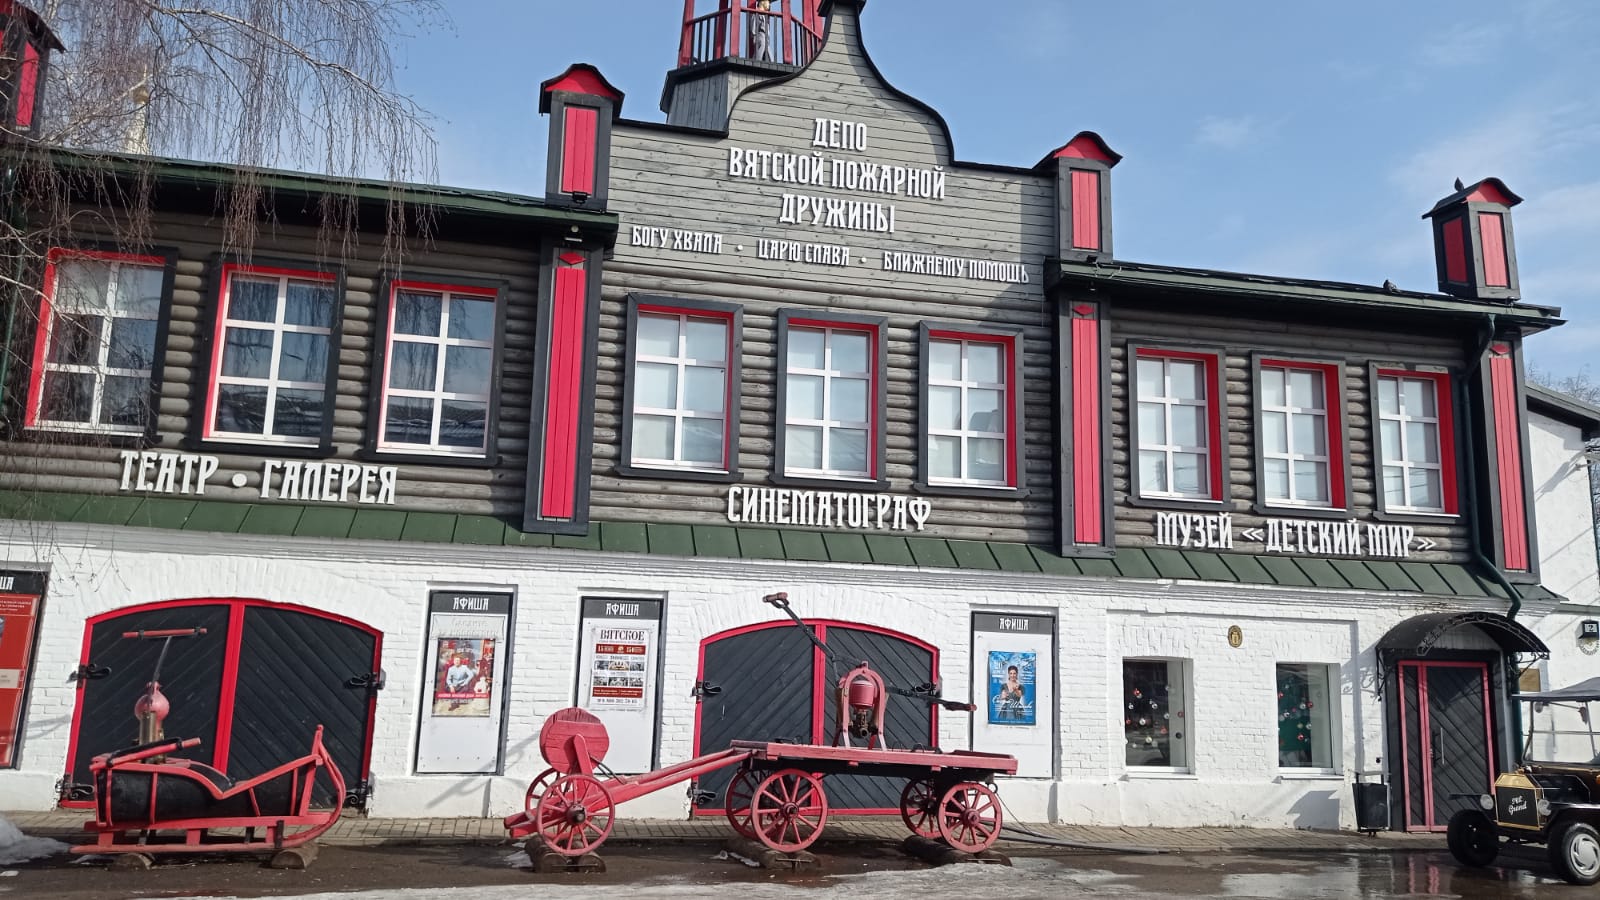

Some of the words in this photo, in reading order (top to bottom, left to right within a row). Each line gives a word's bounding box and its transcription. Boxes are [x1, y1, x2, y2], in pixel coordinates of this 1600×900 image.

[813, 118, 867, 151] ДЕПО
[729, 147, 825, 186] ВЯТСКОЙ
[831, 159, 946, 199] ПОЖАРНОЙ
[779, 194, 895, 233] ДРУЖИНЫ
[632, 226, 669, 248] БОГУ
[672, 231, 722, 254] ХВАЛА
[757, 239, 801, 262] ЦАРЮ
[805, 243, 850, 267] СЛАВА
[883, 252, 964, 278] БЛИЖНЕМУ
[967, 259, 1029, 284] ПОМОЩЬ
[120, 451, 219, 495] ТЕАТР
[260, 460, 398, 505] ГАЛЕРЕЯ
[727, 486, 932, 531] СИНЕМАТОГРАФ
[1156, 511, 1233, 549] МУЗЕЙ
[453, 597, 489, 611] АФИША
[606, 603, 639, 616] АФИША
[600, 630, 645, 640] ВЯТСКОЕ
[1000, 618, 1029, 631] АФИША
